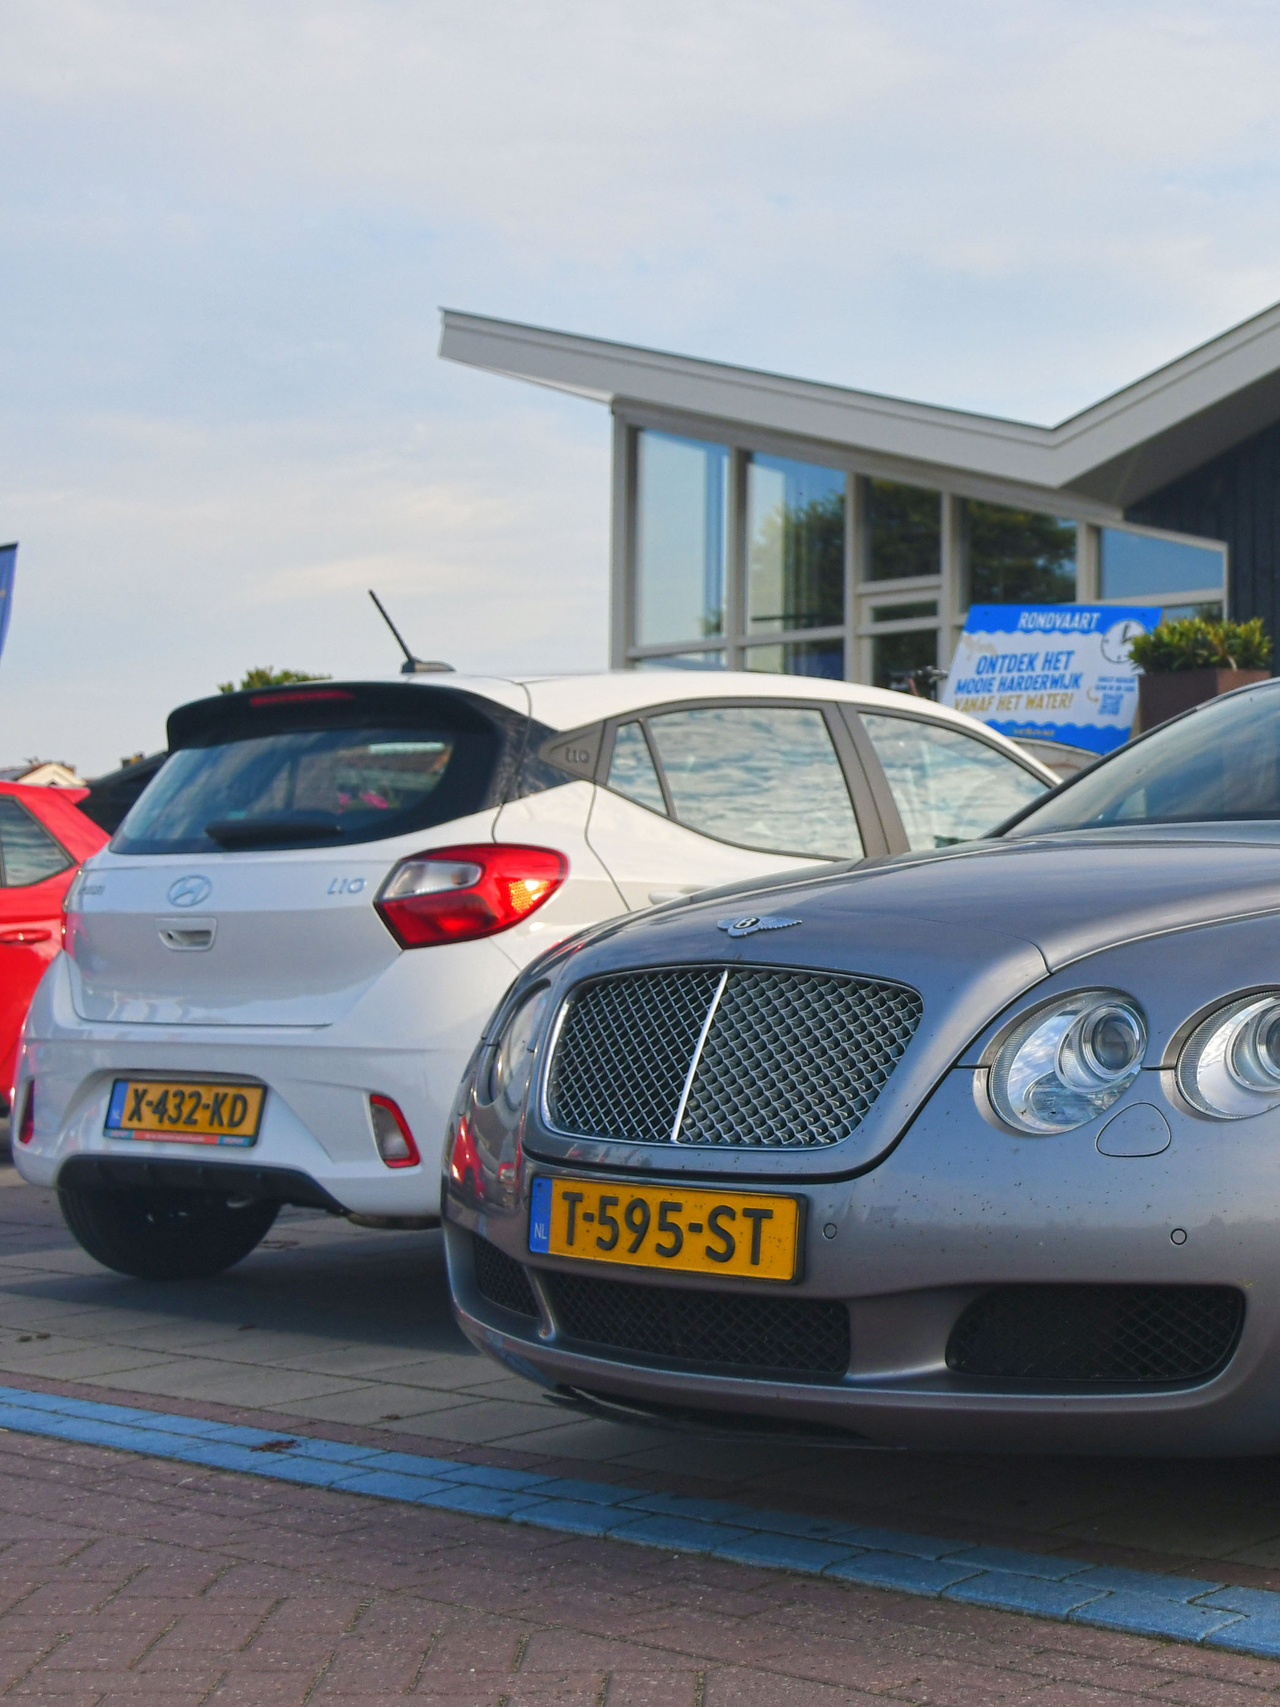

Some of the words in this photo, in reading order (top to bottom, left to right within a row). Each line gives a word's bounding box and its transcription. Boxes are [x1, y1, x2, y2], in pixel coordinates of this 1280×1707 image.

[1018, 612, 1101, 629] RONDVAART
[976, 652, 1039, 675] ONTDEK
[1042, 650, 1075, 672] HET
[956, 677, 996, 695] MOOIE
[997, 672, 1083, 693] HARDERWIJK
[954, 694, 993, 712] VANAF
[996, 693, 1022, 711] HET
[1025, 692, 1074, 710] WATER!
[128, 1088, 248, 1128] X-432-KD
[534, 1222, 547, 1240] NL
[561, 1191, 773, 1266] T-595-ST
